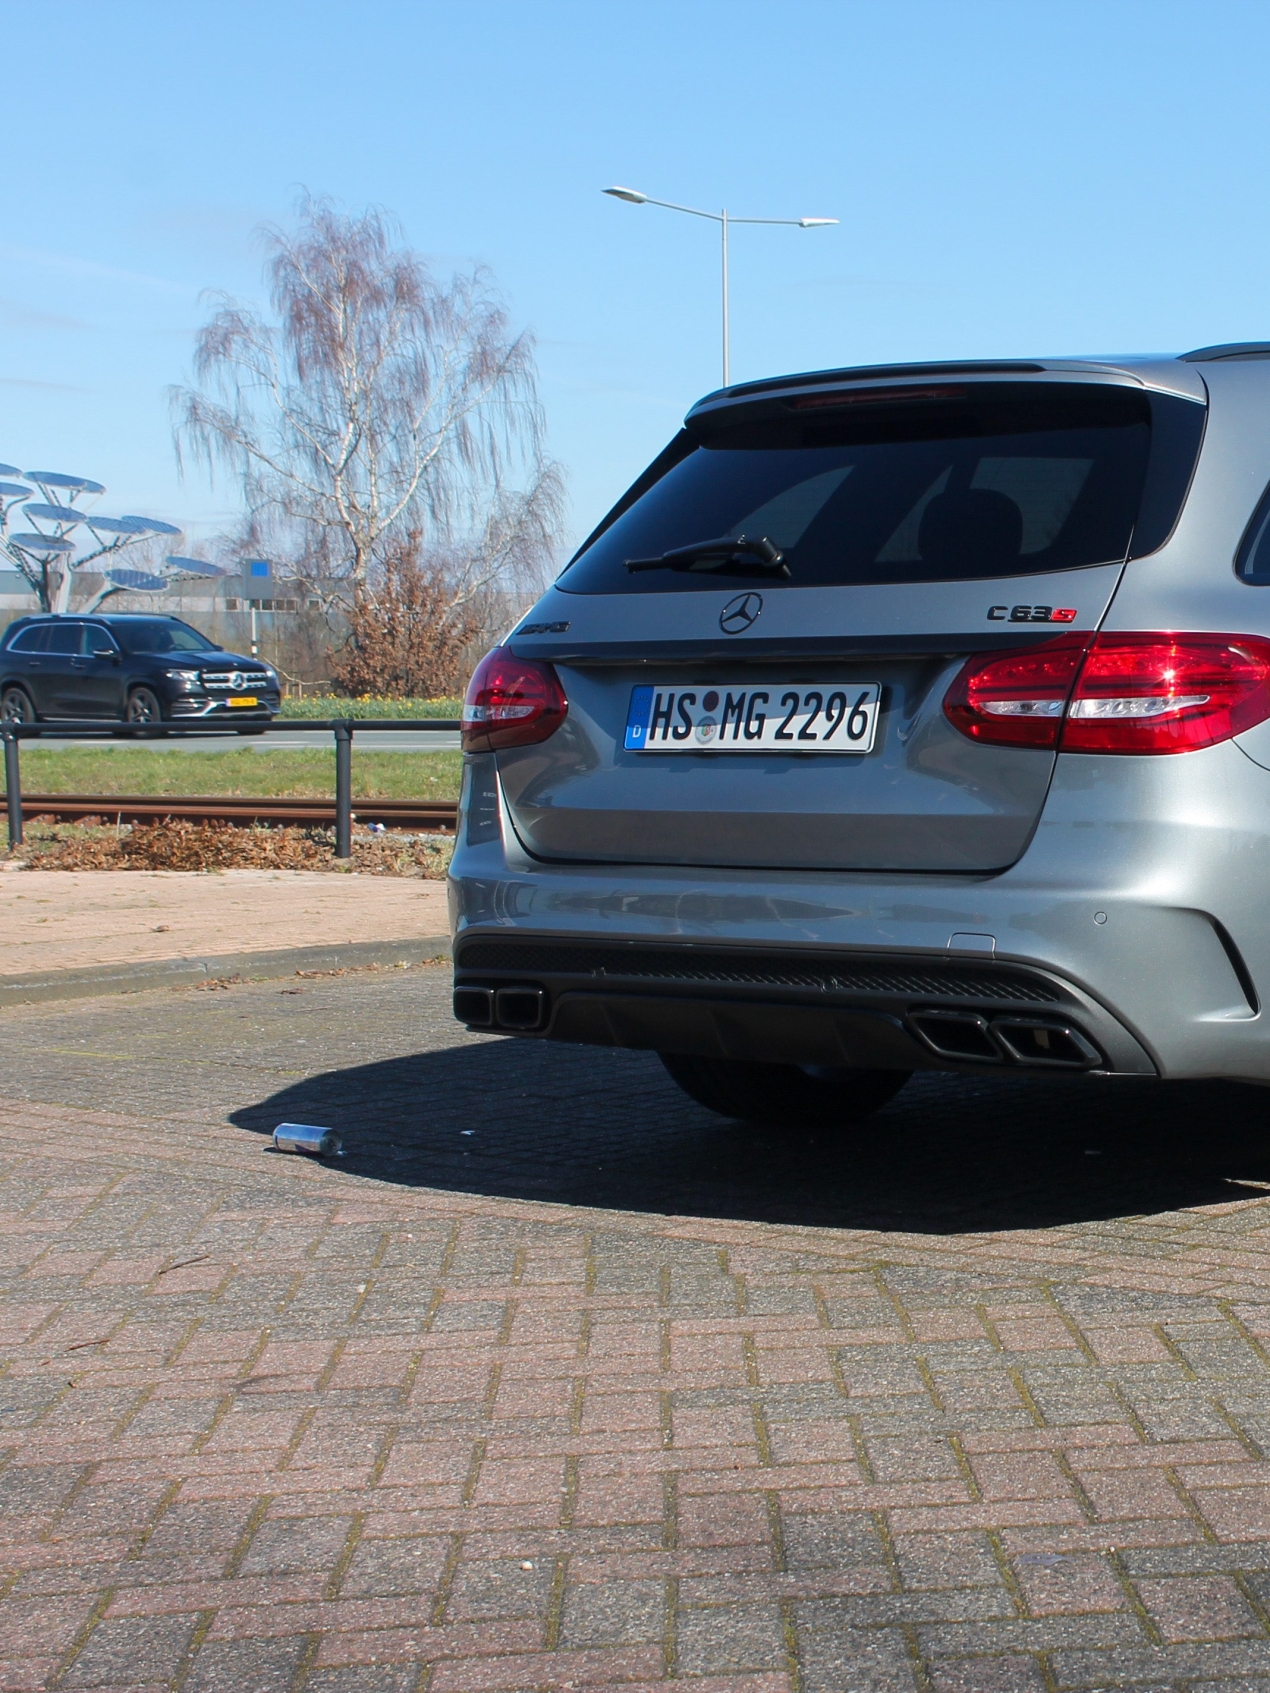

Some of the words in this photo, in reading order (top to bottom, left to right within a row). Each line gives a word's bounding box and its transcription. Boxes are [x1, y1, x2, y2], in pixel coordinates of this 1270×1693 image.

[632, 725, 641, 738] D
[650, 692, 696, 741] HS
[719, 692, 769, 740] MG
[774, 691, 870, 740] 2296
